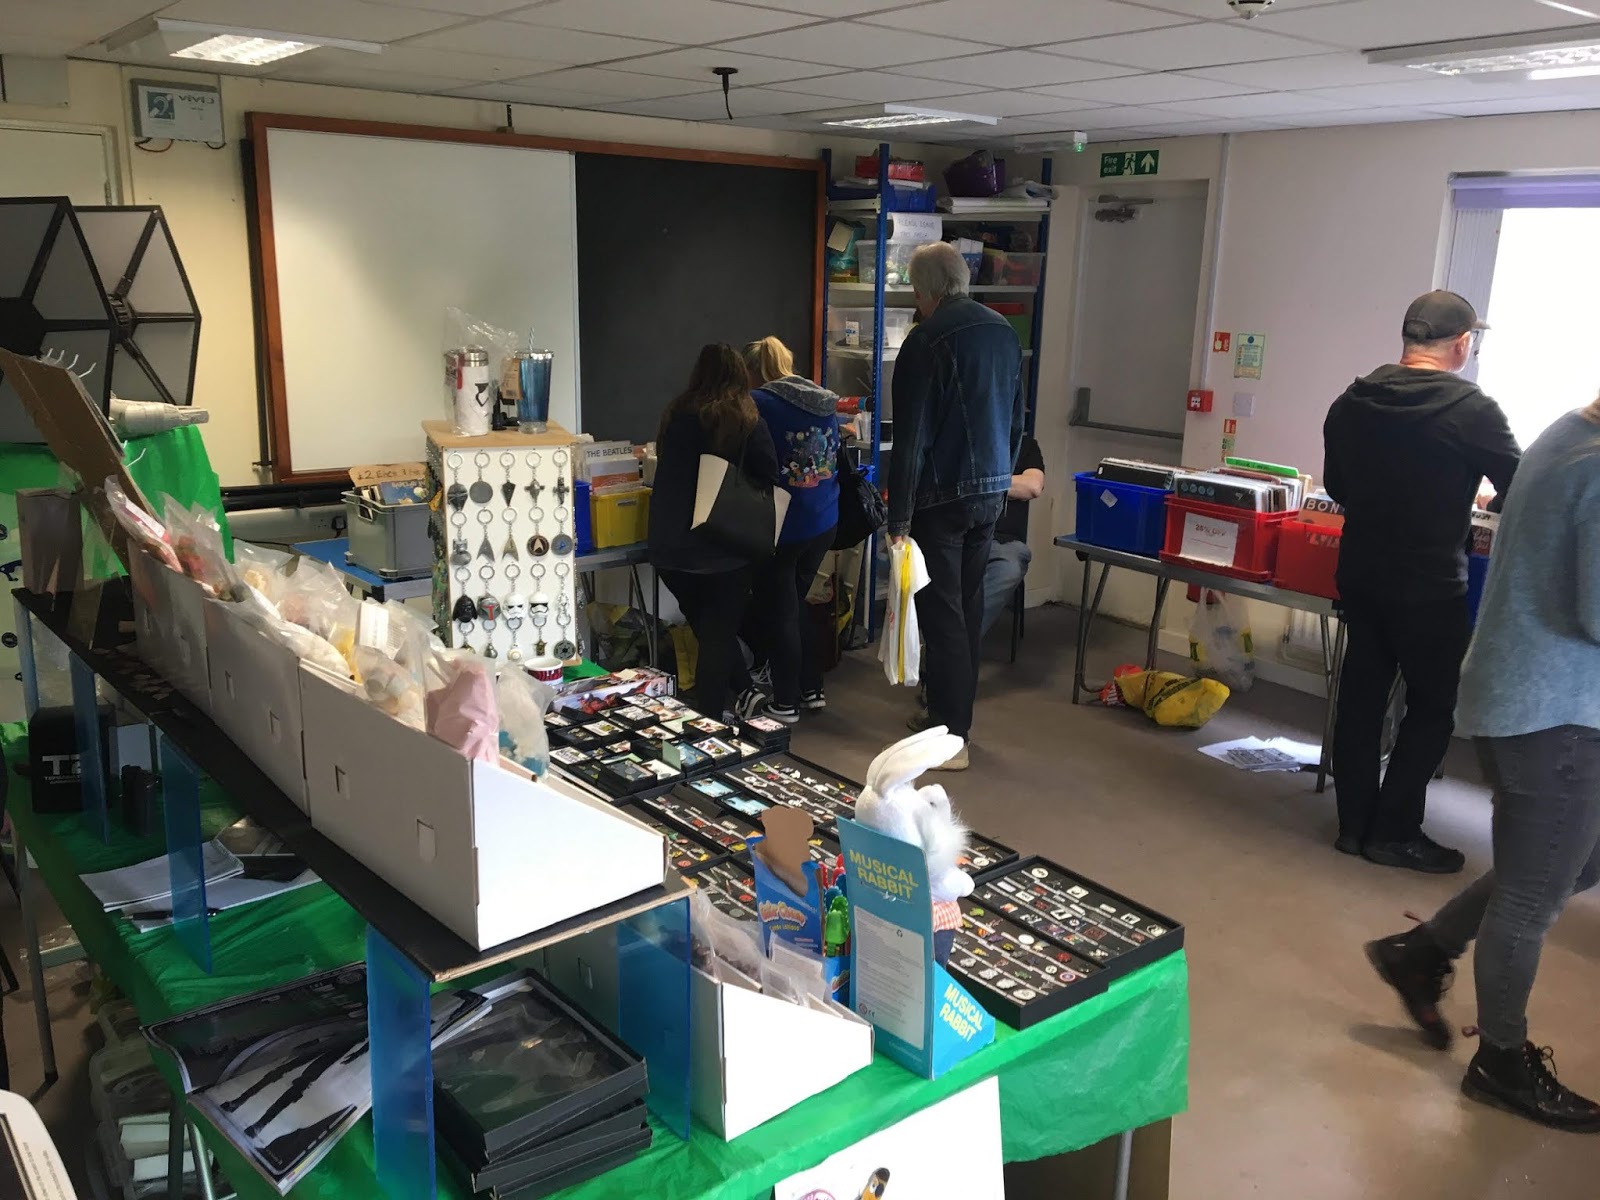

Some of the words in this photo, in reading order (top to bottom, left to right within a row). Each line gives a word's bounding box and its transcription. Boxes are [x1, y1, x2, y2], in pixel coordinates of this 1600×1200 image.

[1103, 165, 1117, 174] exit
[1104, 155, 1118, 165] Fire
[587, 449, 601, 458] THE
[602, 446, 633, 457] BEATLES
[849, 848, 920, 889] MUSICAL
[857, 866, 914, 900] RABBIT
[939, 1002, 977, 1043] RABBIT
[944, 983, 984, 1032] MUSICAL
